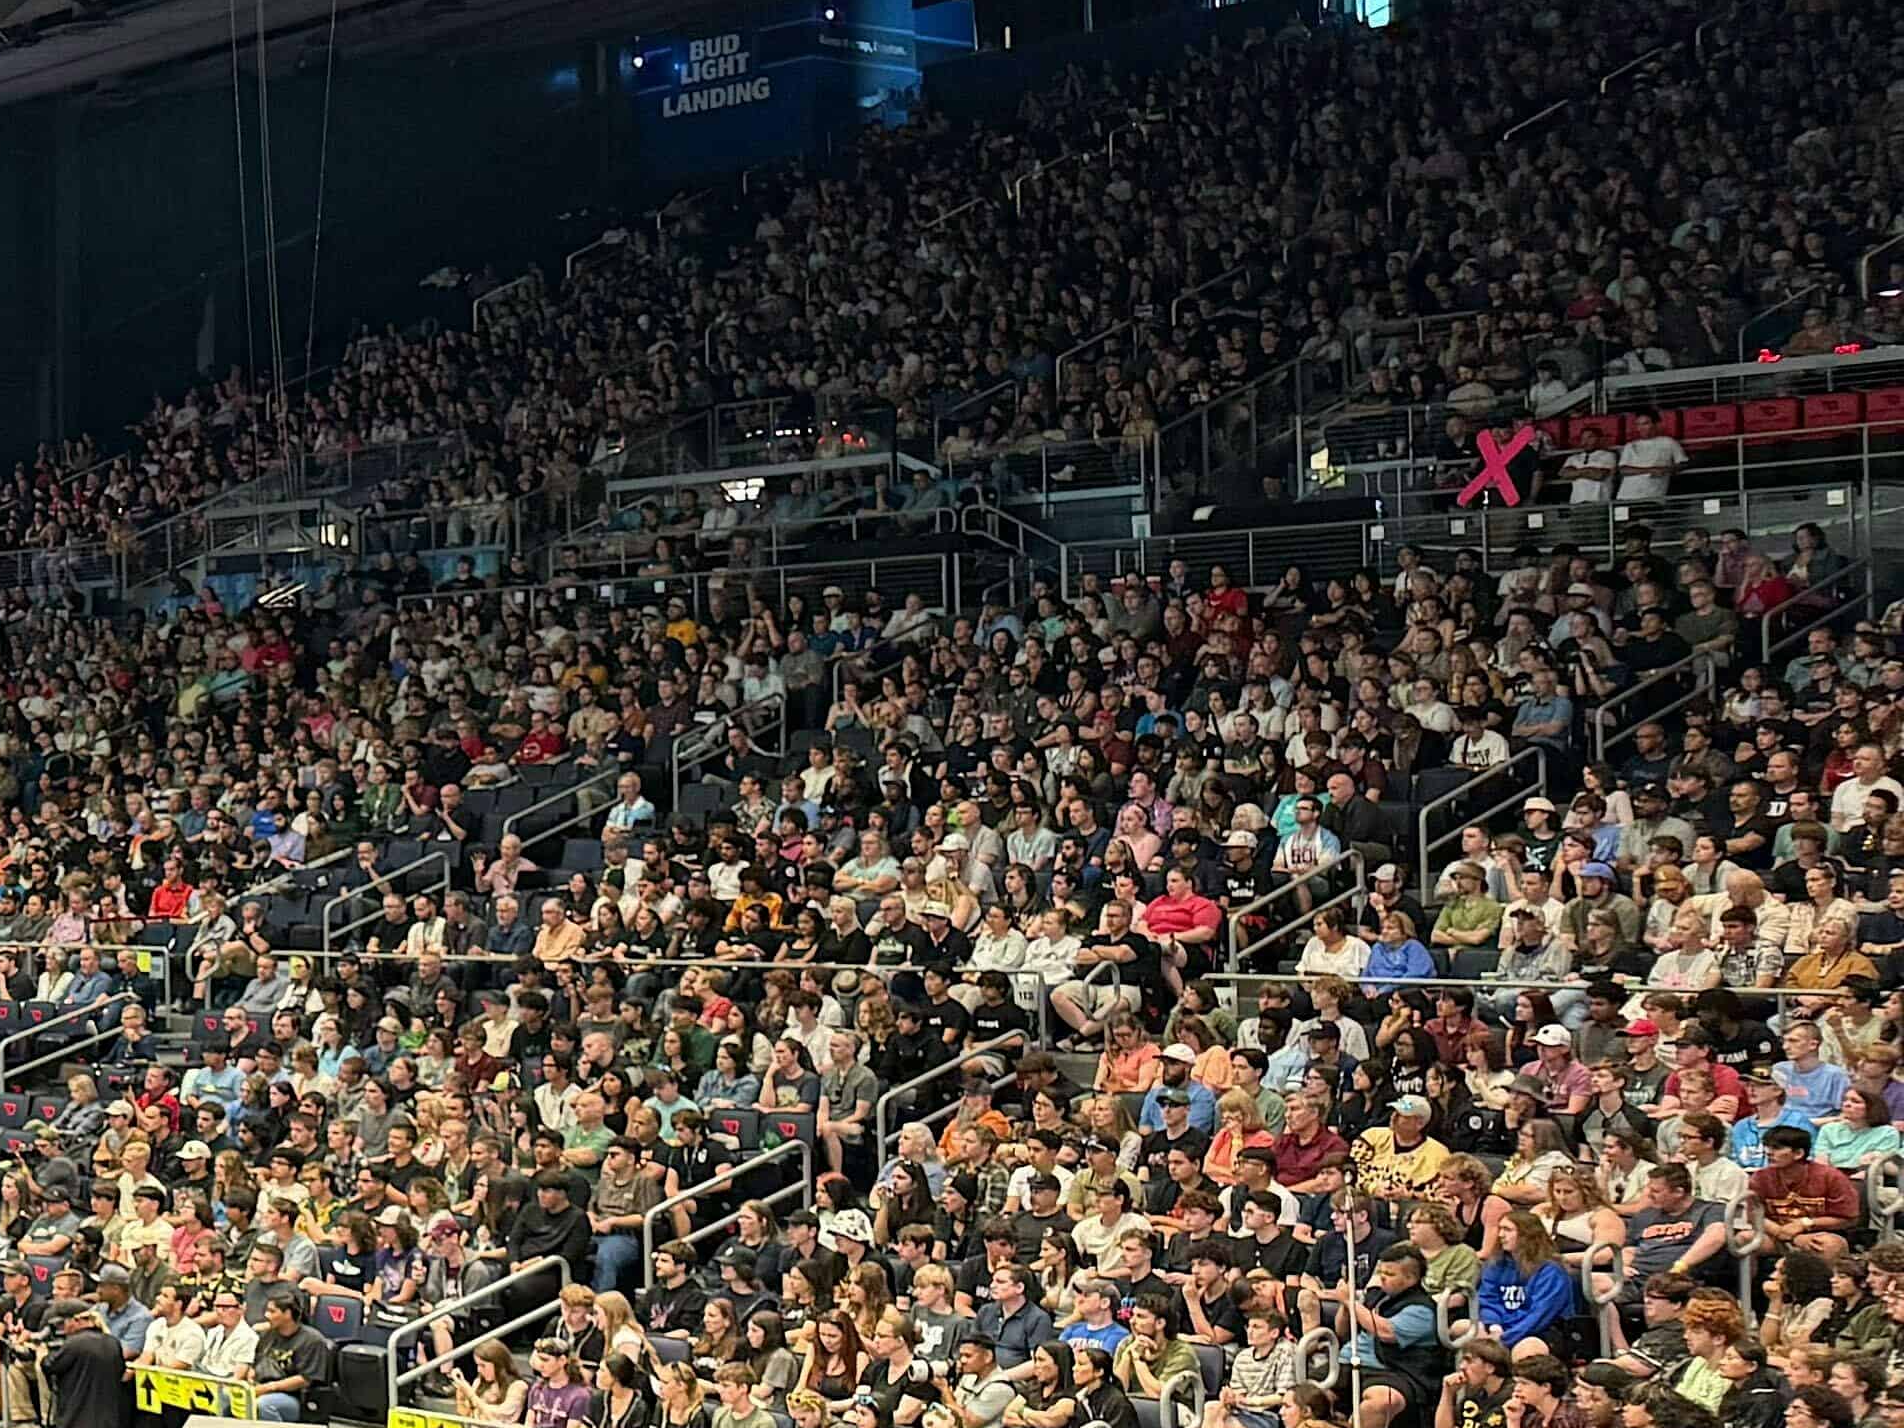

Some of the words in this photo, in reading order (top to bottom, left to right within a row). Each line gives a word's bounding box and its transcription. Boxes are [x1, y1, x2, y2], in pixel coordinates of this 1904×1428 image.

[689, 34, 741, 62] BUD
[680, 51, 750, 85] LIGHT
[662, 77, 771, 118] LANDING
